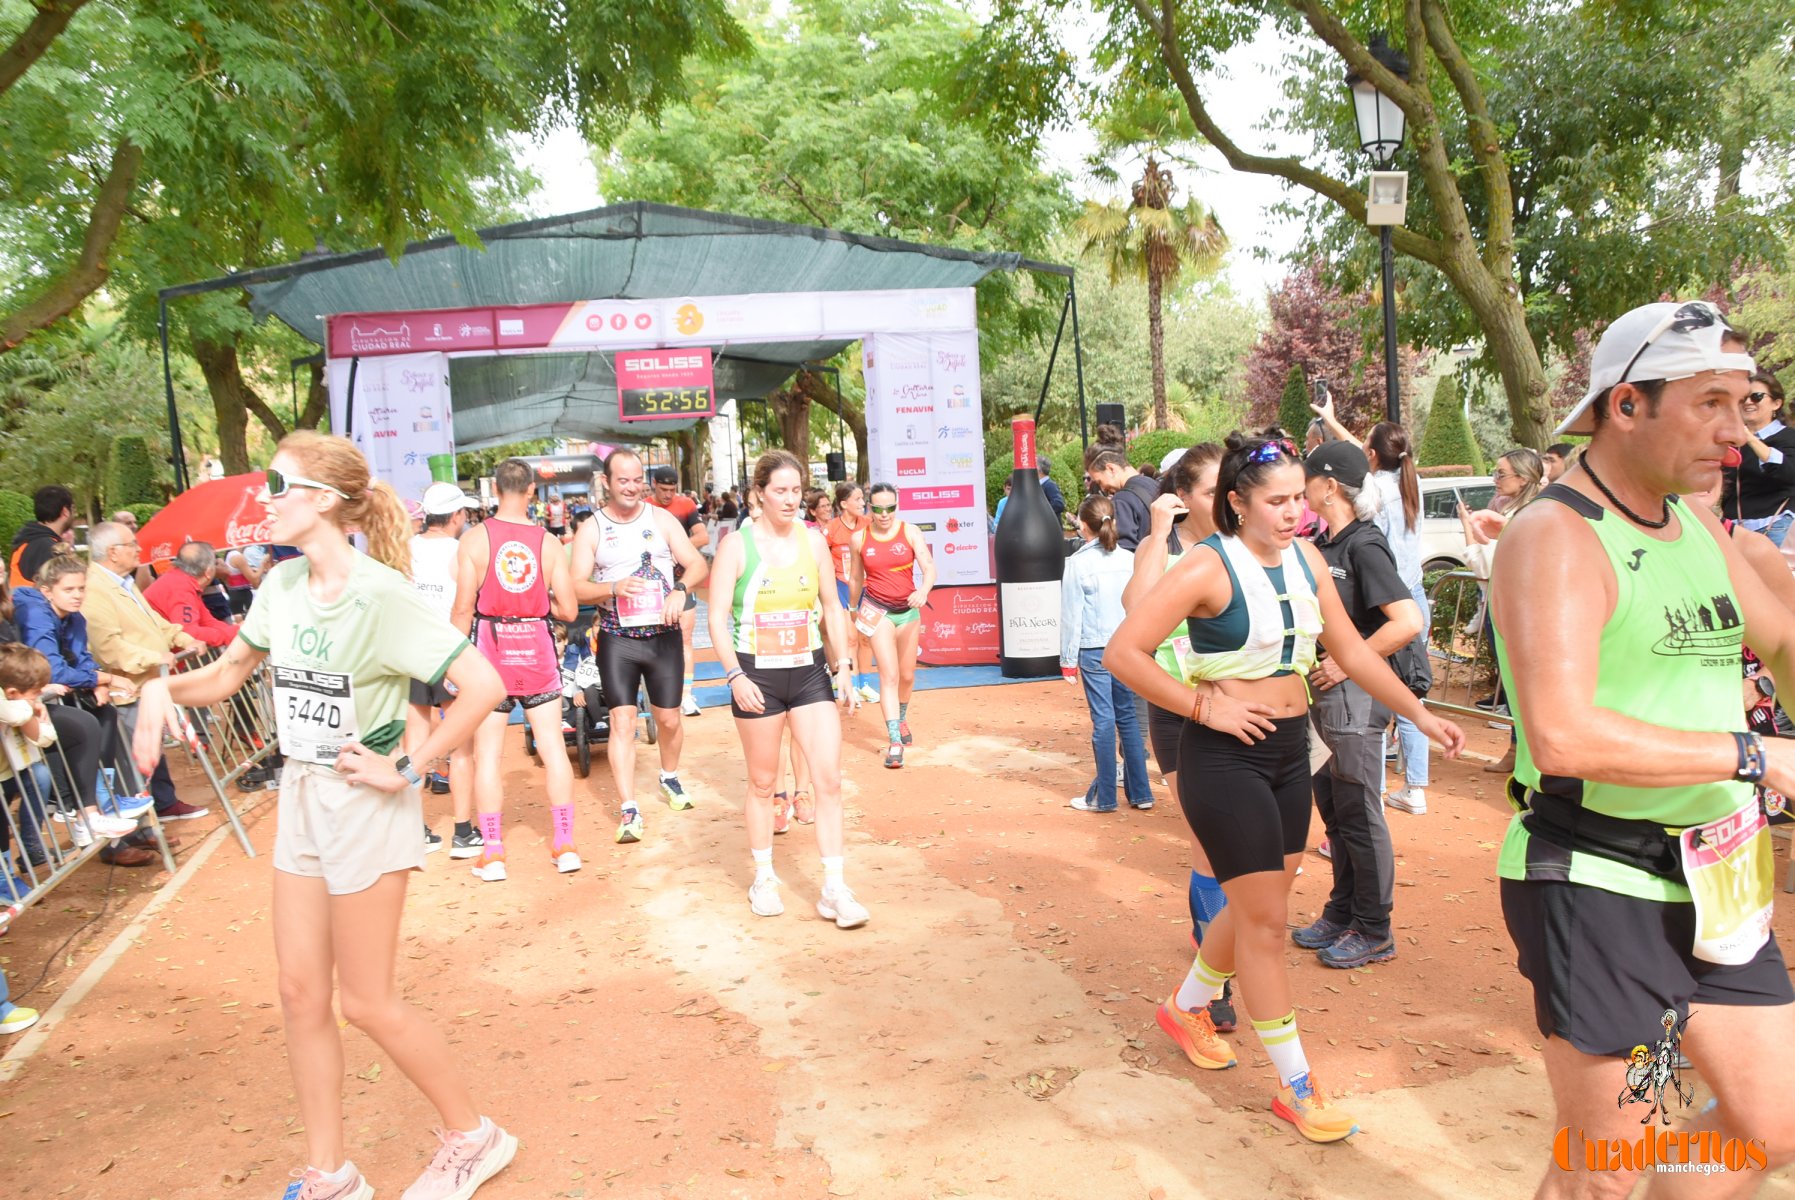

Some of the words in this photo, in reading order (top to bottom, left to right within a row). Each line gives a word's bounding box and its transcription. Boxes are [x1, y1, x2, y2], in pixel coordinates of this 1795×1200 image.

[352, 343, 388, 351] CIUDAD
[389, 341, 411, 349] REAL
[625, 356, 703, 372] SOLISS
[896, 405, 934, 414] FENAVIN
[373, 429, 398, 439] AVIN
[912, 489, 960, 500] SOLISS
[226, 519, 272, 547] Coca-Co
[182, 606, 193, 624] 5
[953, 607, 981, 615] CIUDAD
[778, 629, 796, 646] 13
[277, 667, 344, 689] SOLISS
[1697, 802, 1760, 852] SOLIS
